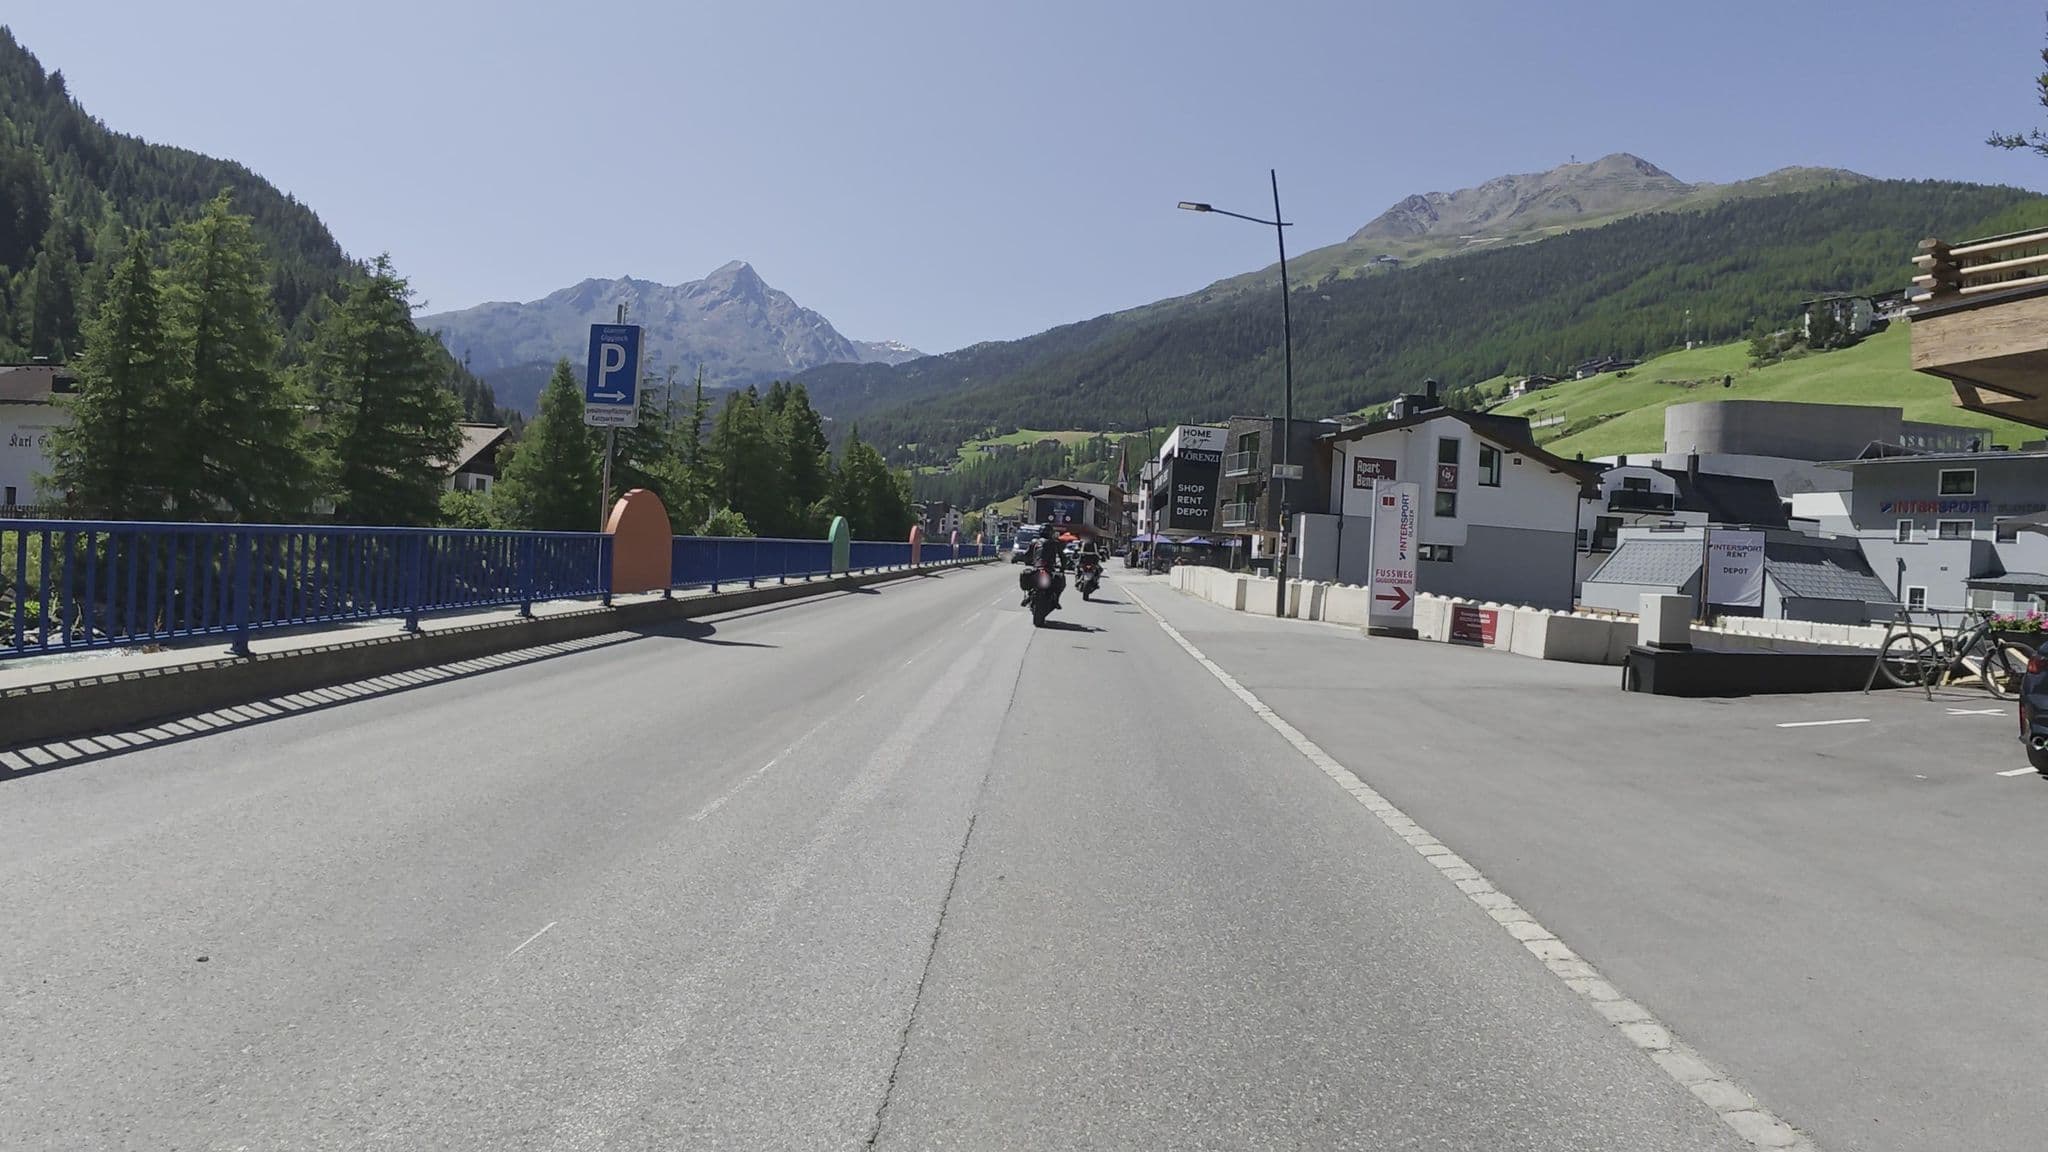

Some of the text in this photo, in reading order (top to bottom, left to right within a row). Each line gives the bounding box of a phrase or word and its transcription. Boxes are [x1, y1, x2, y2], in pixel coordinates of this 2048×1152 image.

[598, 343, 626, 387] P
[1183, 429, 1212, 438] HOME
[1357, 459, 1381, 474] Apart
[1178, 484, 1205, 493] SHOP
[1177, 495, 1203, 505] RENT
[1176, 507, 1209, 517] DEPOT
[1893, 500, 1990, 514] INTERSPORT
[1399, 493, 1409, 552] INTERSPORT
[1713, 544, 1762, 552] INTERSPORT
[1376, 568, 1413, 578] FUSSWEG
[1723, 567, 1748, 575] DEPOT
